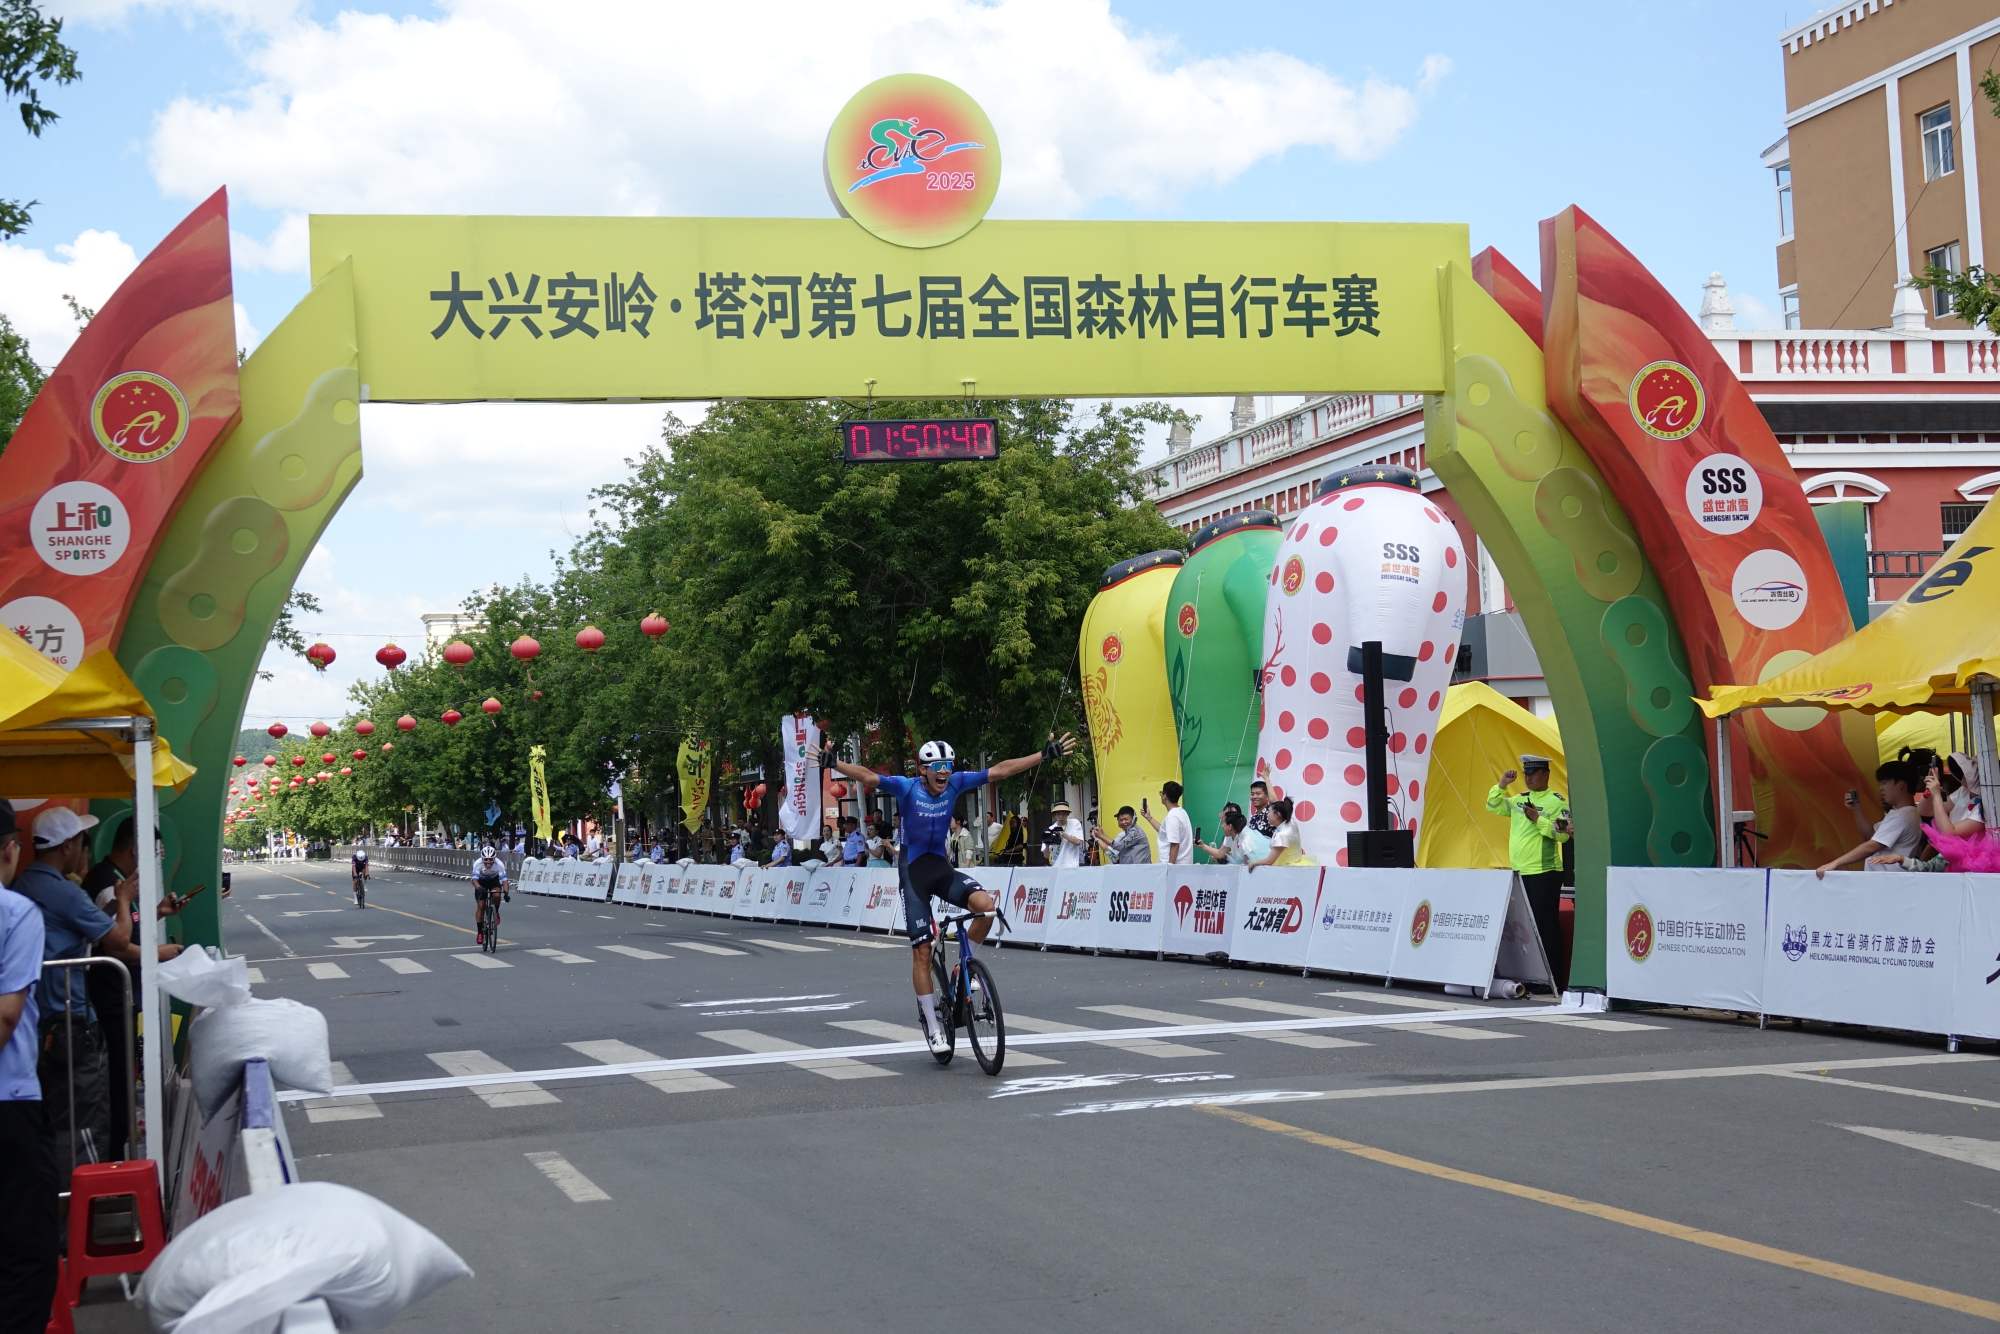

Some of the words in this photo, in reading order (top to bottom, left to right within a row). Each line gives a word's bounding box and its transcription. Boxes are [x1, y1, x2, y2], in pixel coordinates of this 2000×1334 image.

[927, 173, 975, 190] 2025
[429, 270, 1382, 340] 大兴安岭·塔河第七届全国森林自行车赛
[1702, 468, 1747, 495] SSS
[46, 501, 112, 532] 上和
[1703, 498, 1749, 513] 盛世冰雪
[48, 535, 112, 547] SHANGHE
[55, 549, 106, 561] SPORTS
[1383, 542, 1420, 563] SSS
[1109, 891, 1130, 922] SSS
[1195, 889, 1228, 911] 泰坦体育
[1024, 904, 1045, 924] TITAN
[1194, 910, 1225, 934] TITAN
[1243, 906, 1288, 932] 大正体育
[1657, 919, 1746, 942] 中国自行车运动协会
[1657, 943, 1681, 953] CHINESE
[1681, 944, 1705, 955] CYCLING
[1706, 945, 1746, 957] ASSOCIATION
[1810, 931, 1936, 955] 黑龙江省骑行旅游协会
[1809, 952, 1848, 963] HEILONGJIANG
[1848, 954, 1881, 966] PROVINCIAL
[1882, 957, 1908, 967] CYCLING
[1908, 959, 1935, 969] TOURISM
